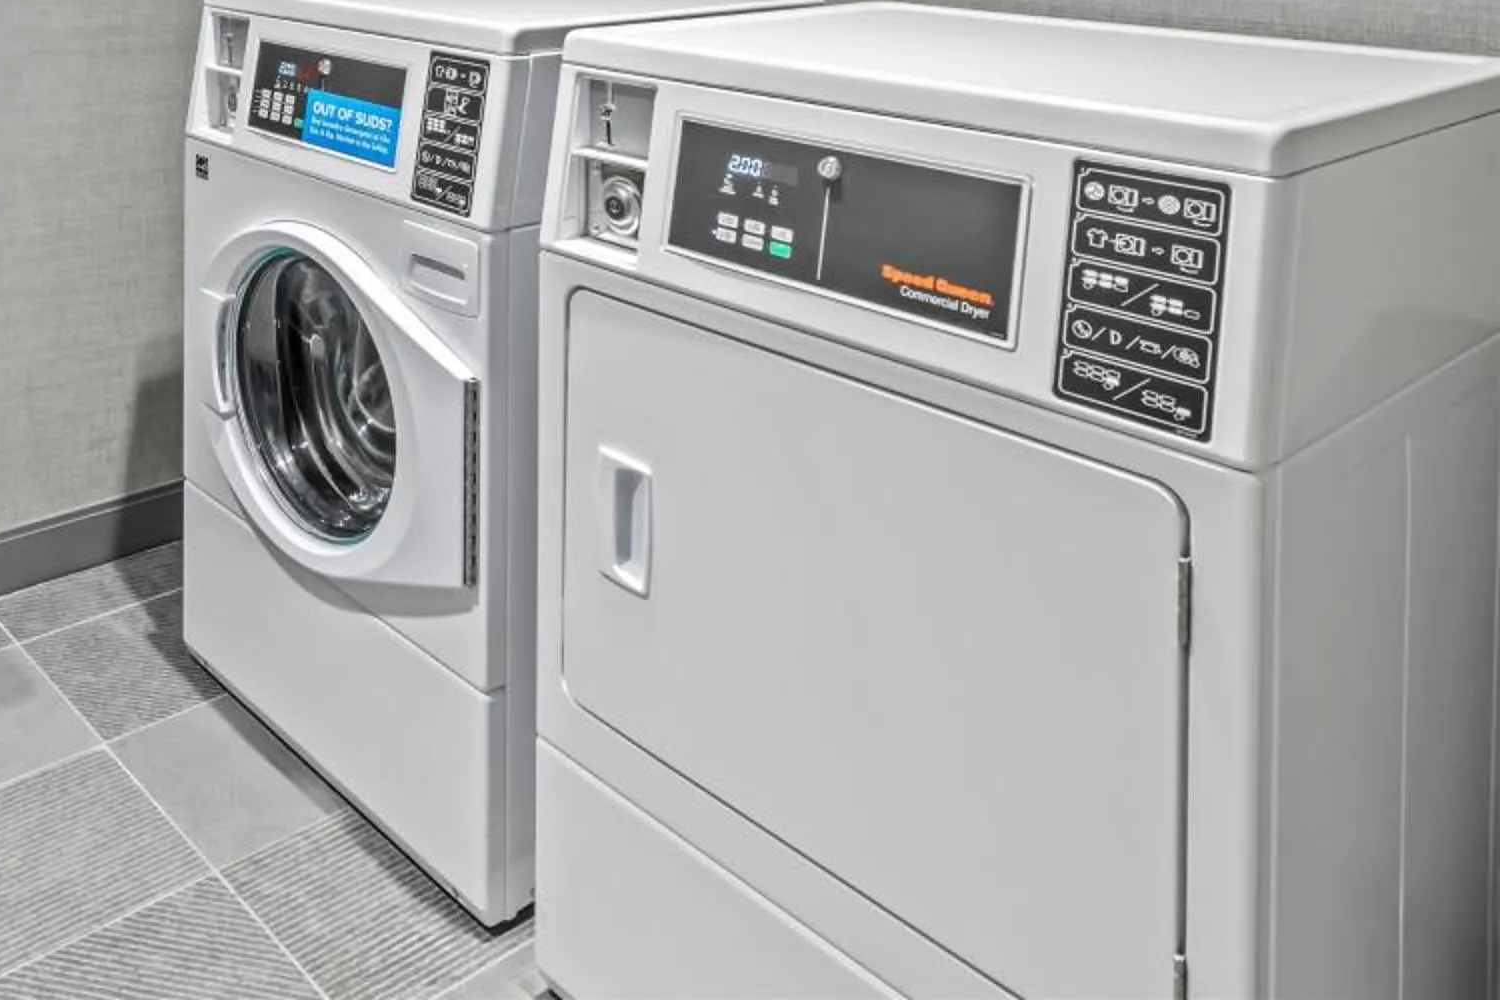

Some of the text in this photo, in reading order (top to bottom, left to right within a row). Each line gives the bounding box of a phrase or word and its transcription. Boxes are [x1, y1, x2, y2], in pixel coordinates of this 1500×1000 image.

[313, 101, 336, 118] OUT
[337, 107, 354, 121] OF
[355, 112, 393, 132] SUDS?
[961, 302, 991, 319] Dryer
